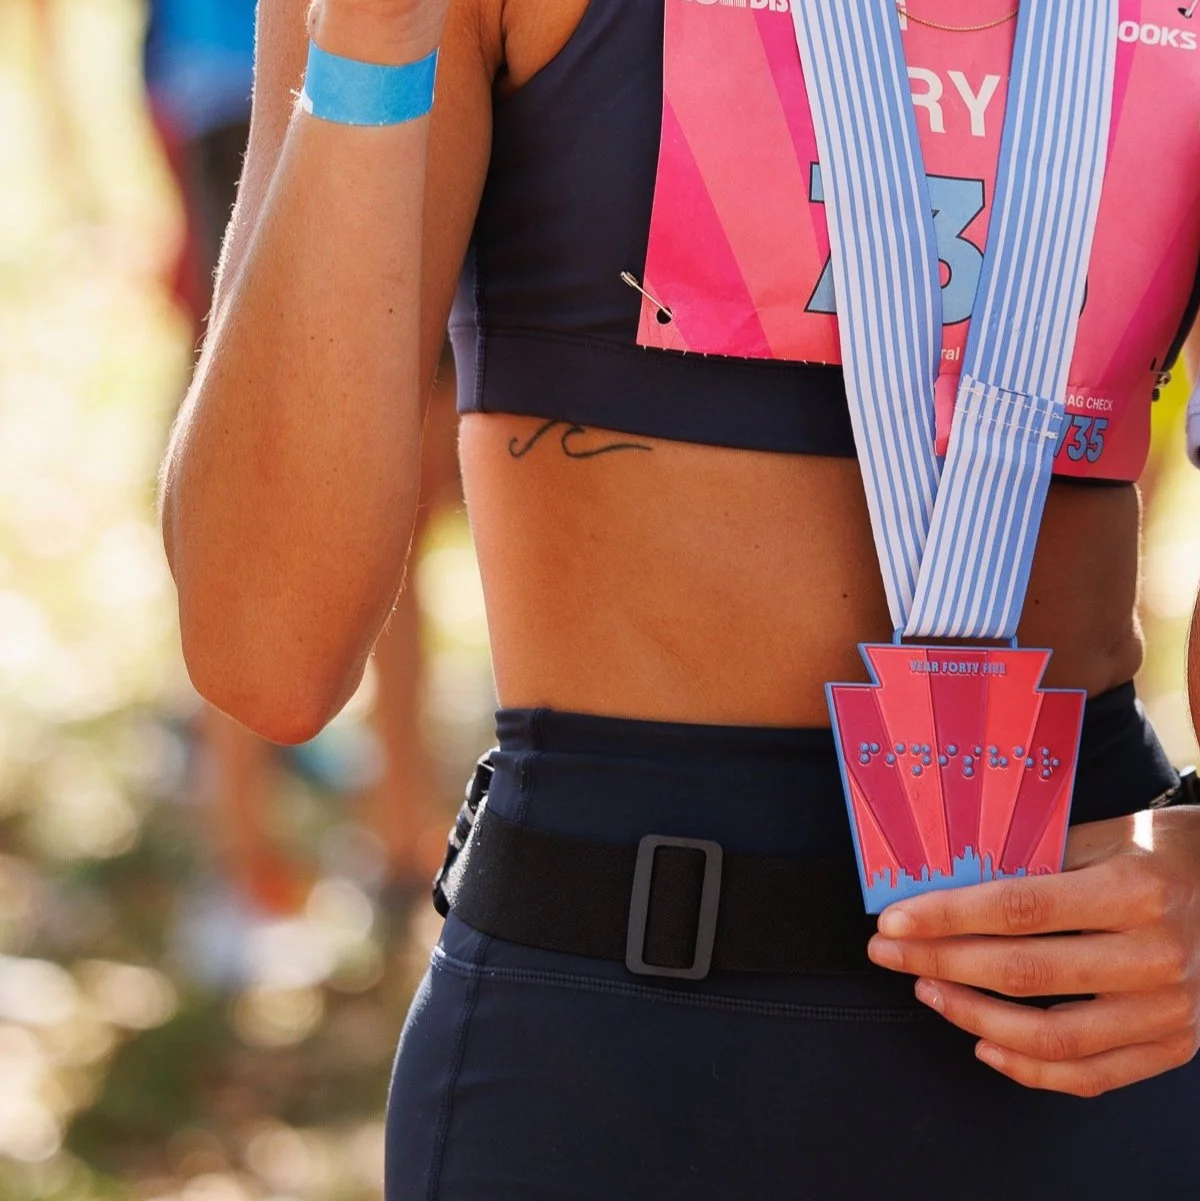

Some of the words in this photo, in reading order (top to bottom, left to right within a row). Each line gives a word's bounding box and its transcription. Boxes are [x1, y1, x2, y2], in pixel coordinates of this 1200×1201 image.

[1118, 20, 1198, 51] OOKS
[906, 65, 1001, 137] RY
[1066, 393, 1084, 408] AG
[1086, 397, 1113, 411] CHECK
[910, 661, 939, 673] YEAR
[942, 661, 979, 673] FORTY
